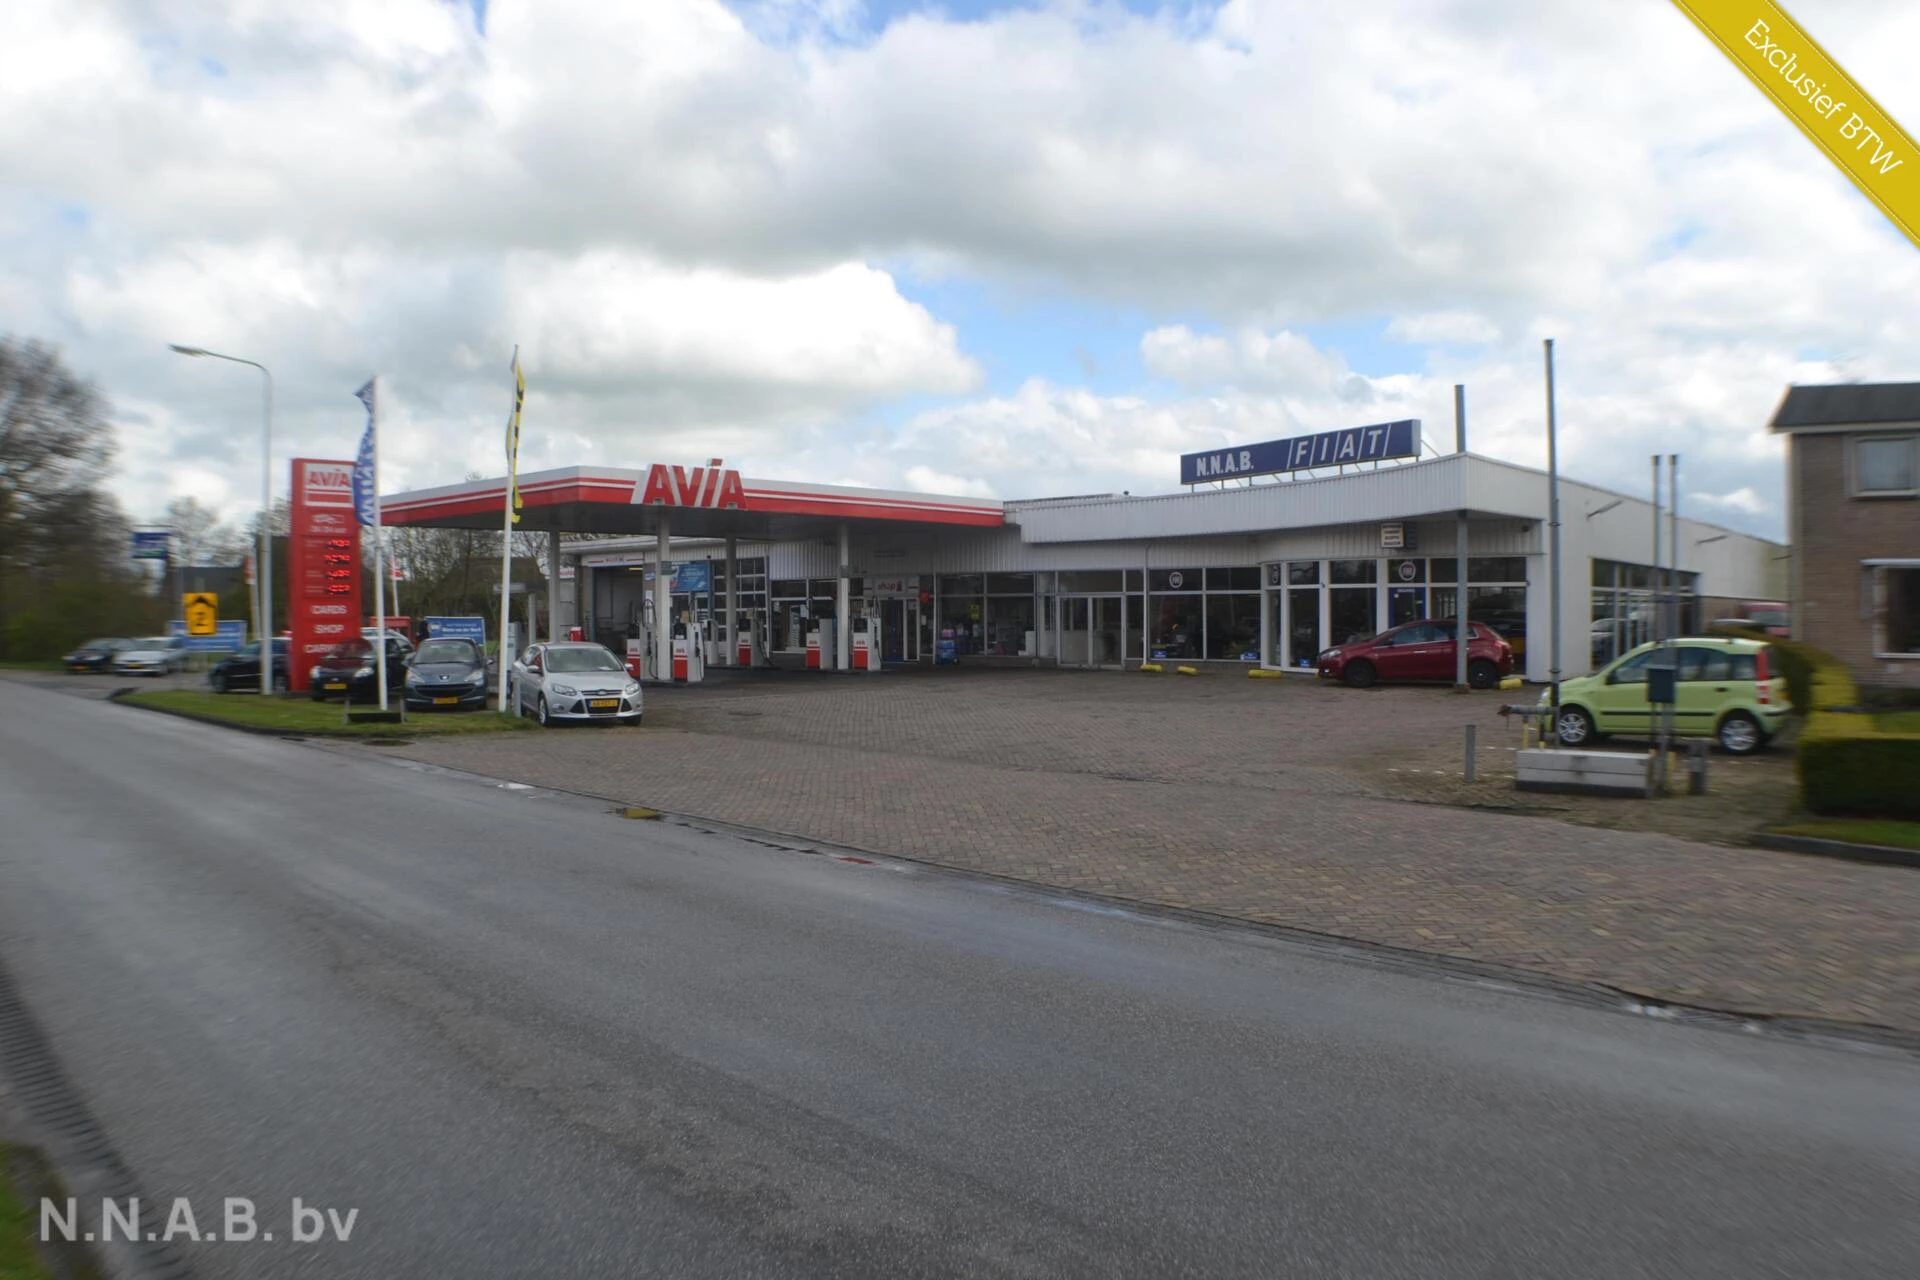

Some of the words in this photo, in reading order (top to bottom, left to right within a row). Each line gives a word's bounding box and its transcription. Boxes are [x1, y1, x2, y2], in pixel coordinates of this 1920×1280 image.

[1196, 450, 1254, 477] N.N.A.B.
[1296, 429, 1383, 464] FIAT
[314, 624, 345, 634] SHOP
